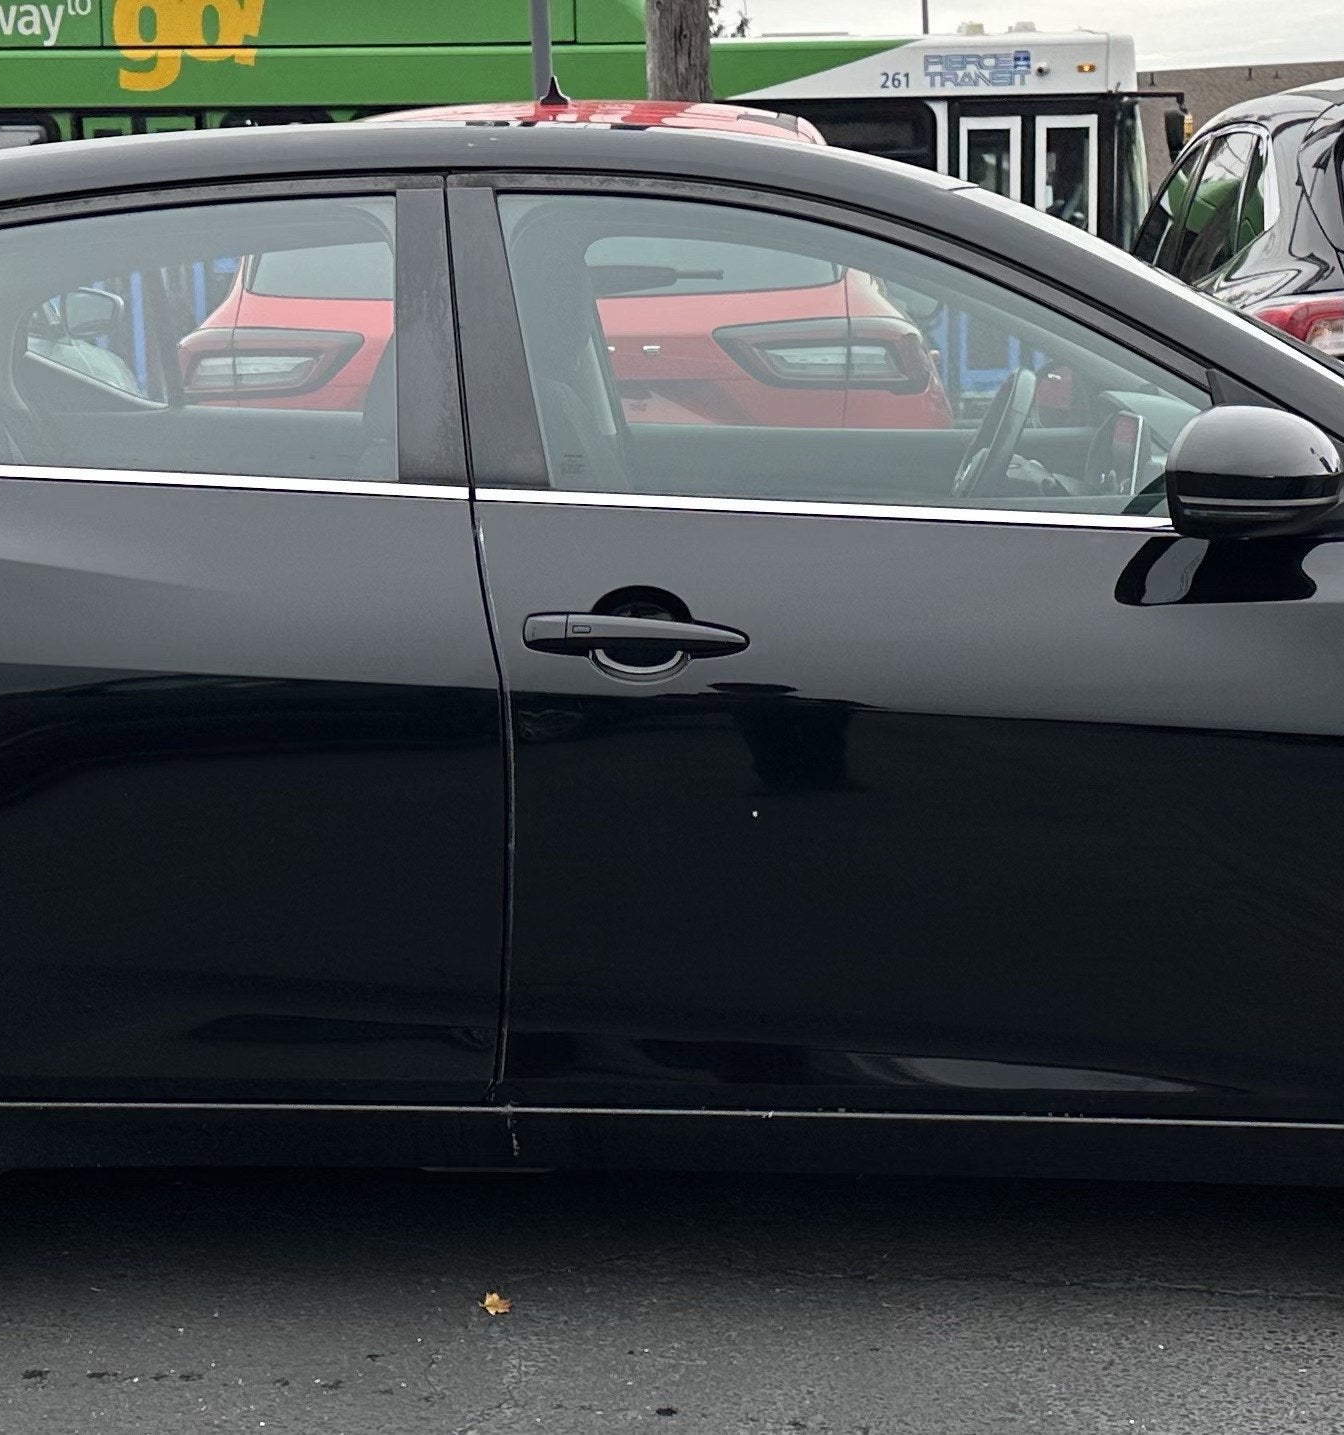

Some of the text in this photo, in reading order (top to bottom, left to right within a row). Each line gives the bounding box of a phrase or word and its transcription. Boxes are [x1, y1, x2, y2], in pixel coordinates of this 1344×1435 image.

[67, 0, 92, 16] to
[924, 54, 1014, 71] PIERCE
[880, 72, 910, 89] 261
[924, 70, 1030, 87] TRANSIT
